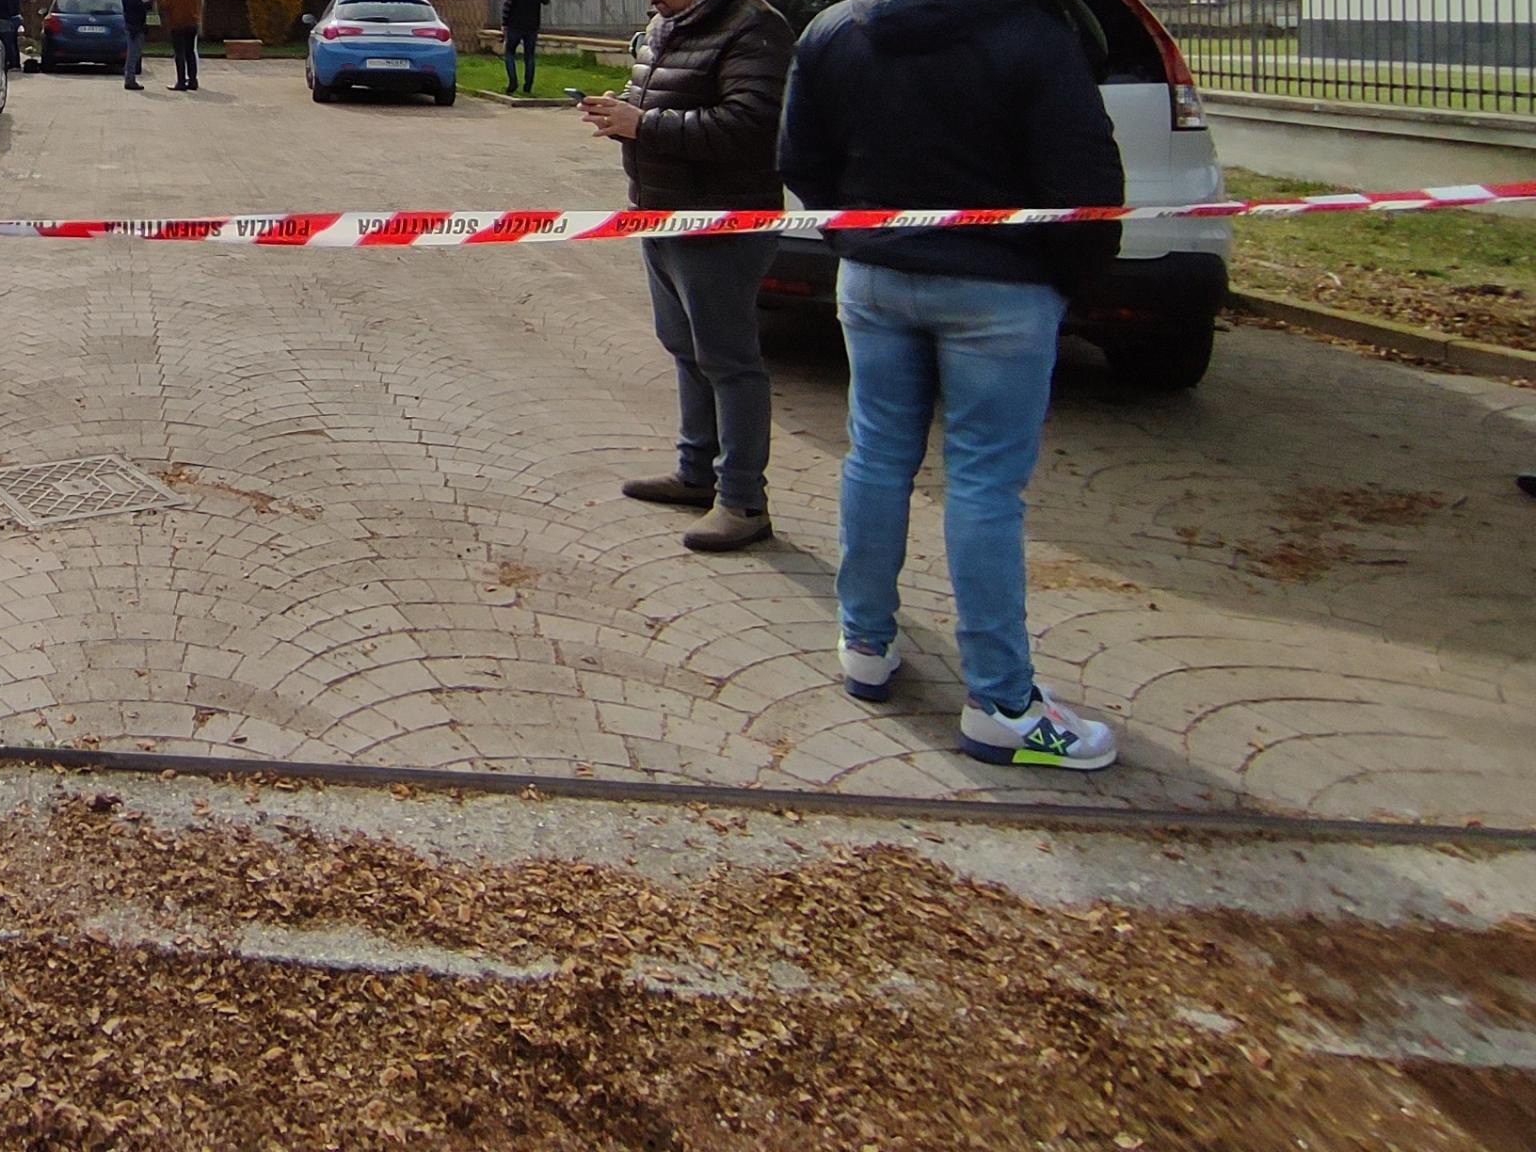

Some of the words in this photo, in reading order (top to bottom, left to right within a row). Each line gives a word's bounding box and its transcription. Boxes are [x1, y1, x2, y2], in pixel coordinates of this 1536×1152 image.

[237, 219, 311, 237] POLIZIA
[357, 218, 479, 235] SCIENTIFICA
[493, 218, 567, 235] POLIZIA
[614, 217, 740, 233] SCIENTIFICA
